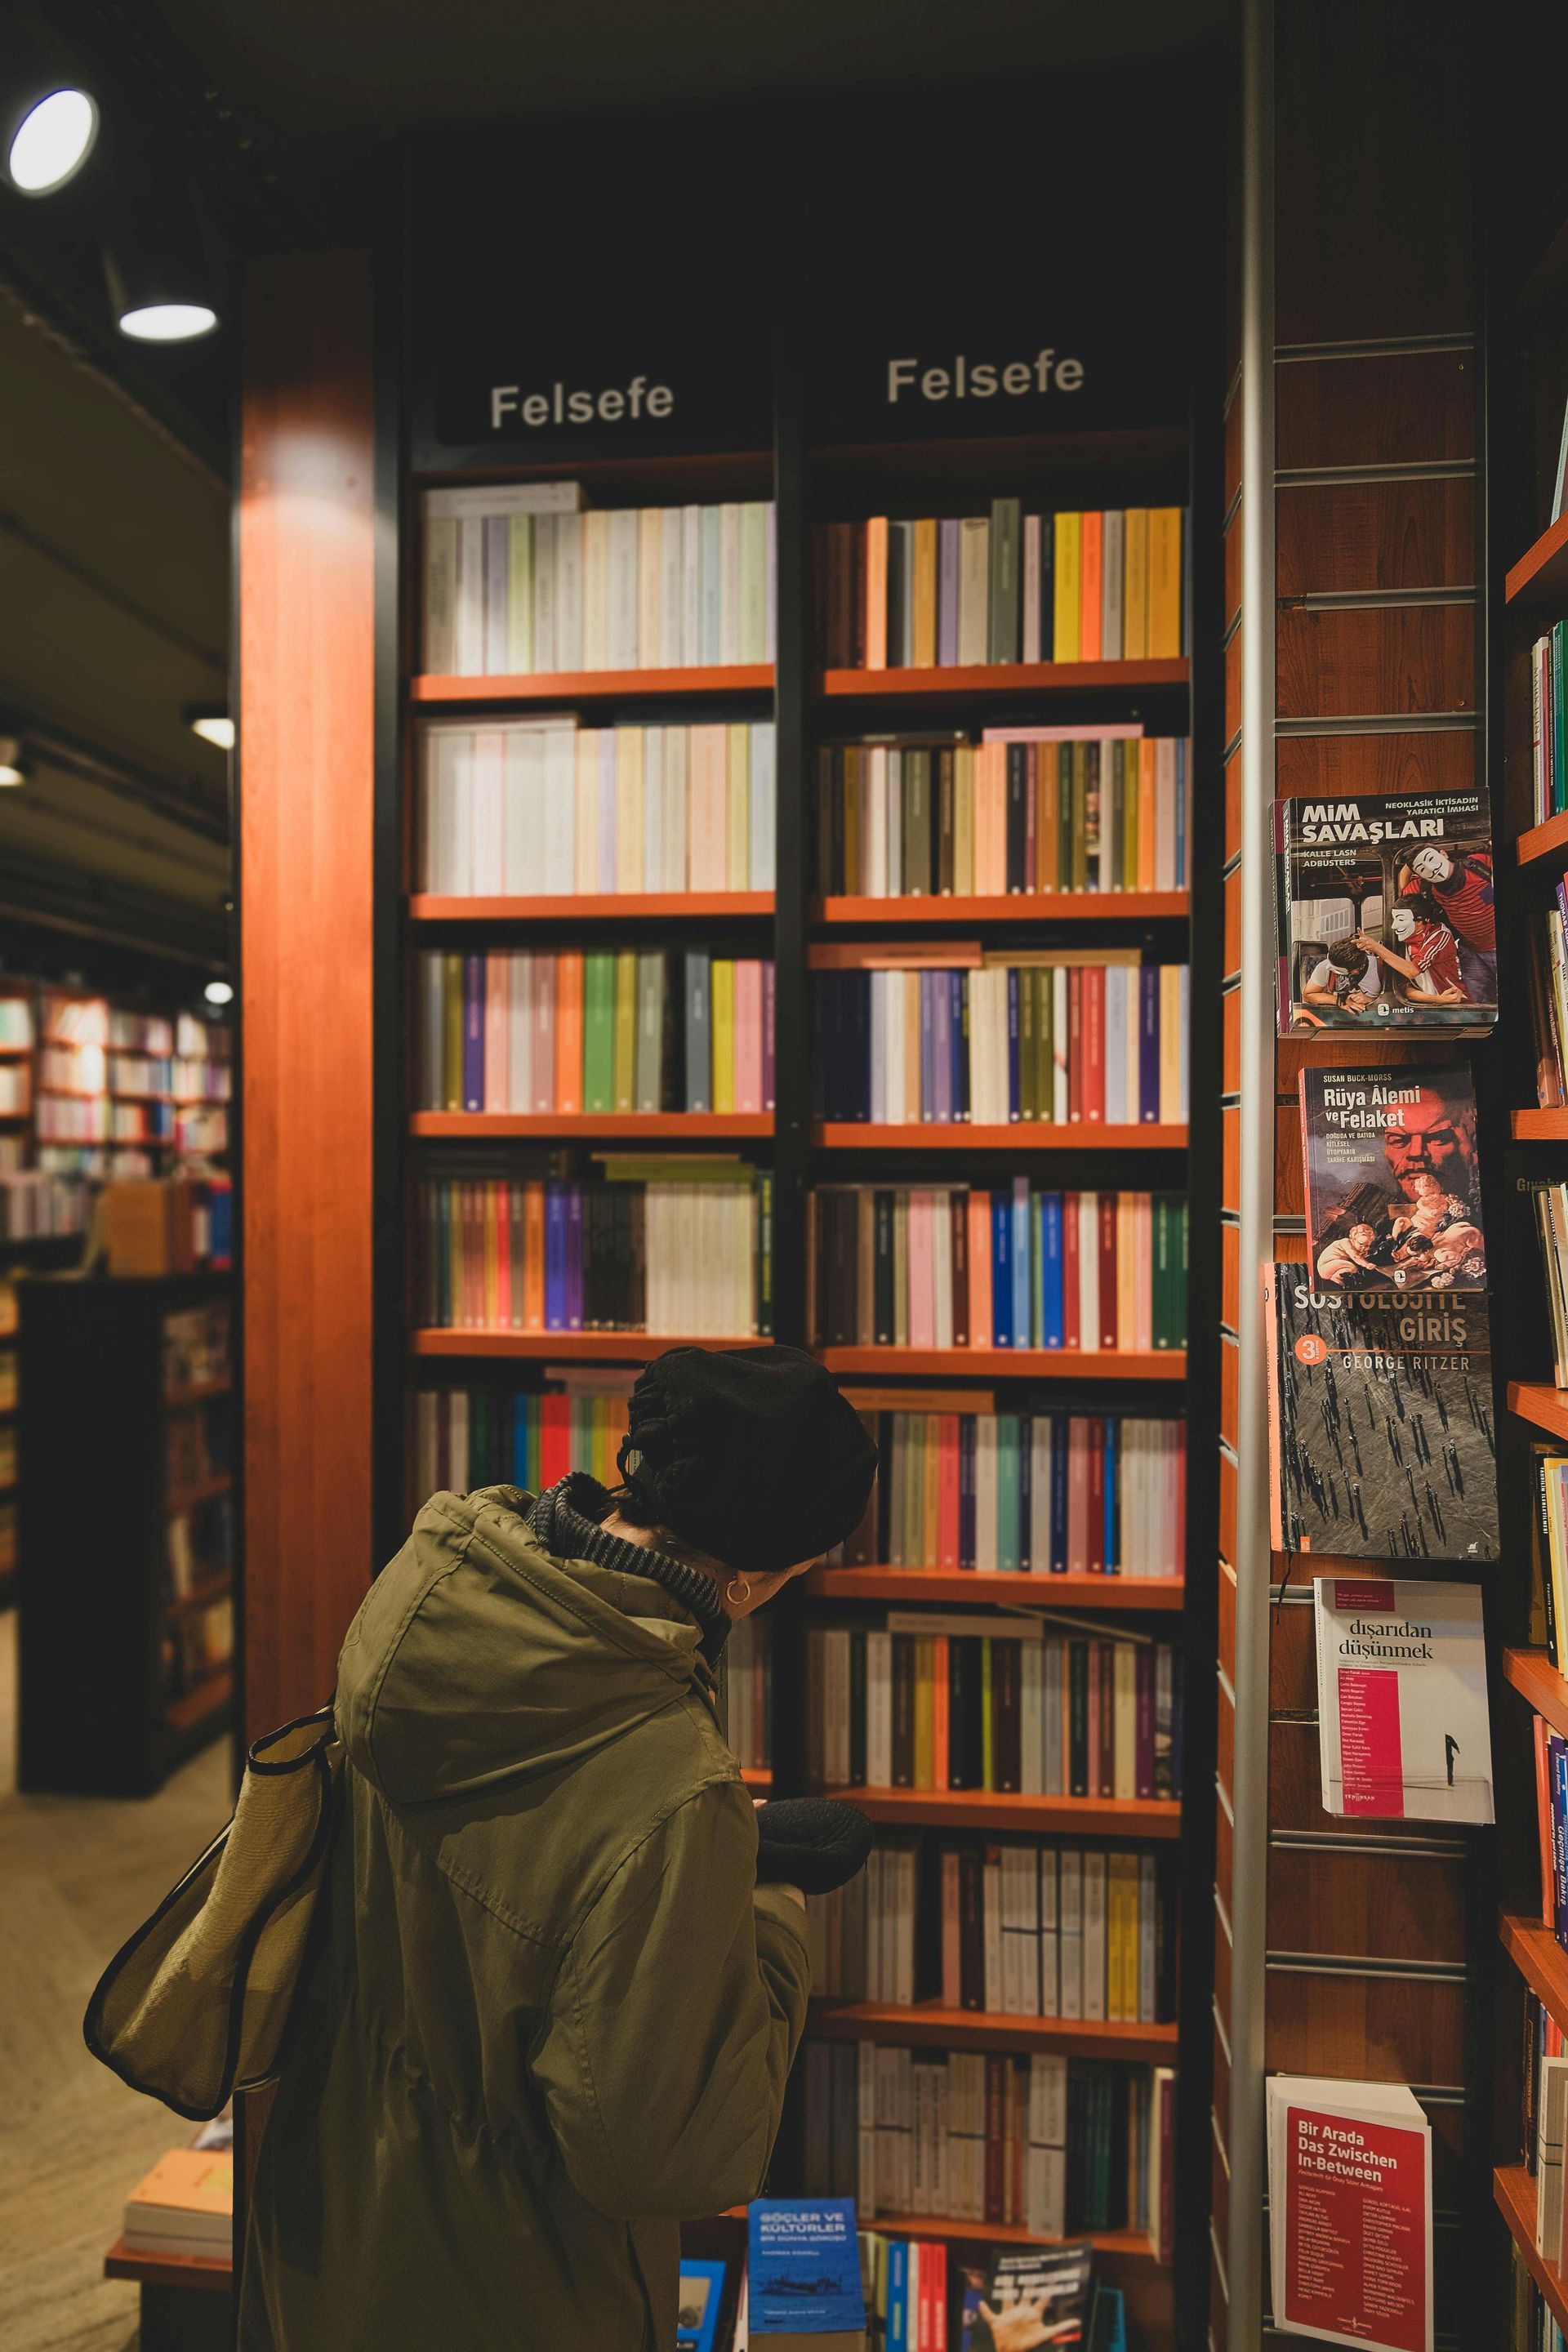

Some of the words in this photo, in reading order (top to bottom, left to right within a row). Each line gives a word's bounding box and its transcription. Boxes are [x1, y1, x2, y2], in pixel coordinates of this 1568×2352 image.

[887, 350, 1085, 404] Felsefe
[491, 377, 675, 430] Felsefe
[1385, 798, 1433, 809] NEOKLASİK
[1435, 795, 1479, 806] İKTİSADIN
[1406, 807, 1446, 816] YARATICI
[1447, 804, 1479, 813] İMHASI
[1302, 818, 1445, 844] SAVAŞLARI
[1303, 858, 1356, 868] ADBUSTERS
[1323, 1075, 1345, 1083] SUSAN
[1347, 1073, 1392, 1082] BUCK-MORSS
[1324, 1088, 1366, 1110] Rüya
[1372, 1085, 1421, 1105] Âlemi
[1325, 1111, 1339, 1121] ve
[1340, 1109, 1405, 1129] Felaket
[1399, 1312, 1468, 1348] GİRİŞ
[1302, 1339, 1316, 1360] 3
[1343, 1356, 1405, 1370] GEORGE
[1413, 1356, 1469, 1371] RITZER
[1349, 1619, 1432, 1639] dışarıdan
[1339, 1639, 1433, 1659] düşünmek
[1298, 2119, 1319, 2136] Bir
[1322, 2125, 1364, 2146] Arada
[1298, 2136, 1324, 2154] Das
[1328, 2142, 1397, 2169] Zwischen
[1298, 2153, 1382, 2183] In-Between
[760, 2212, 821, 2223] GÖÇLER
[824, 2212, 844, 2221] VE
[760, 2222, 846, 2234] KÜLTÜRLER
